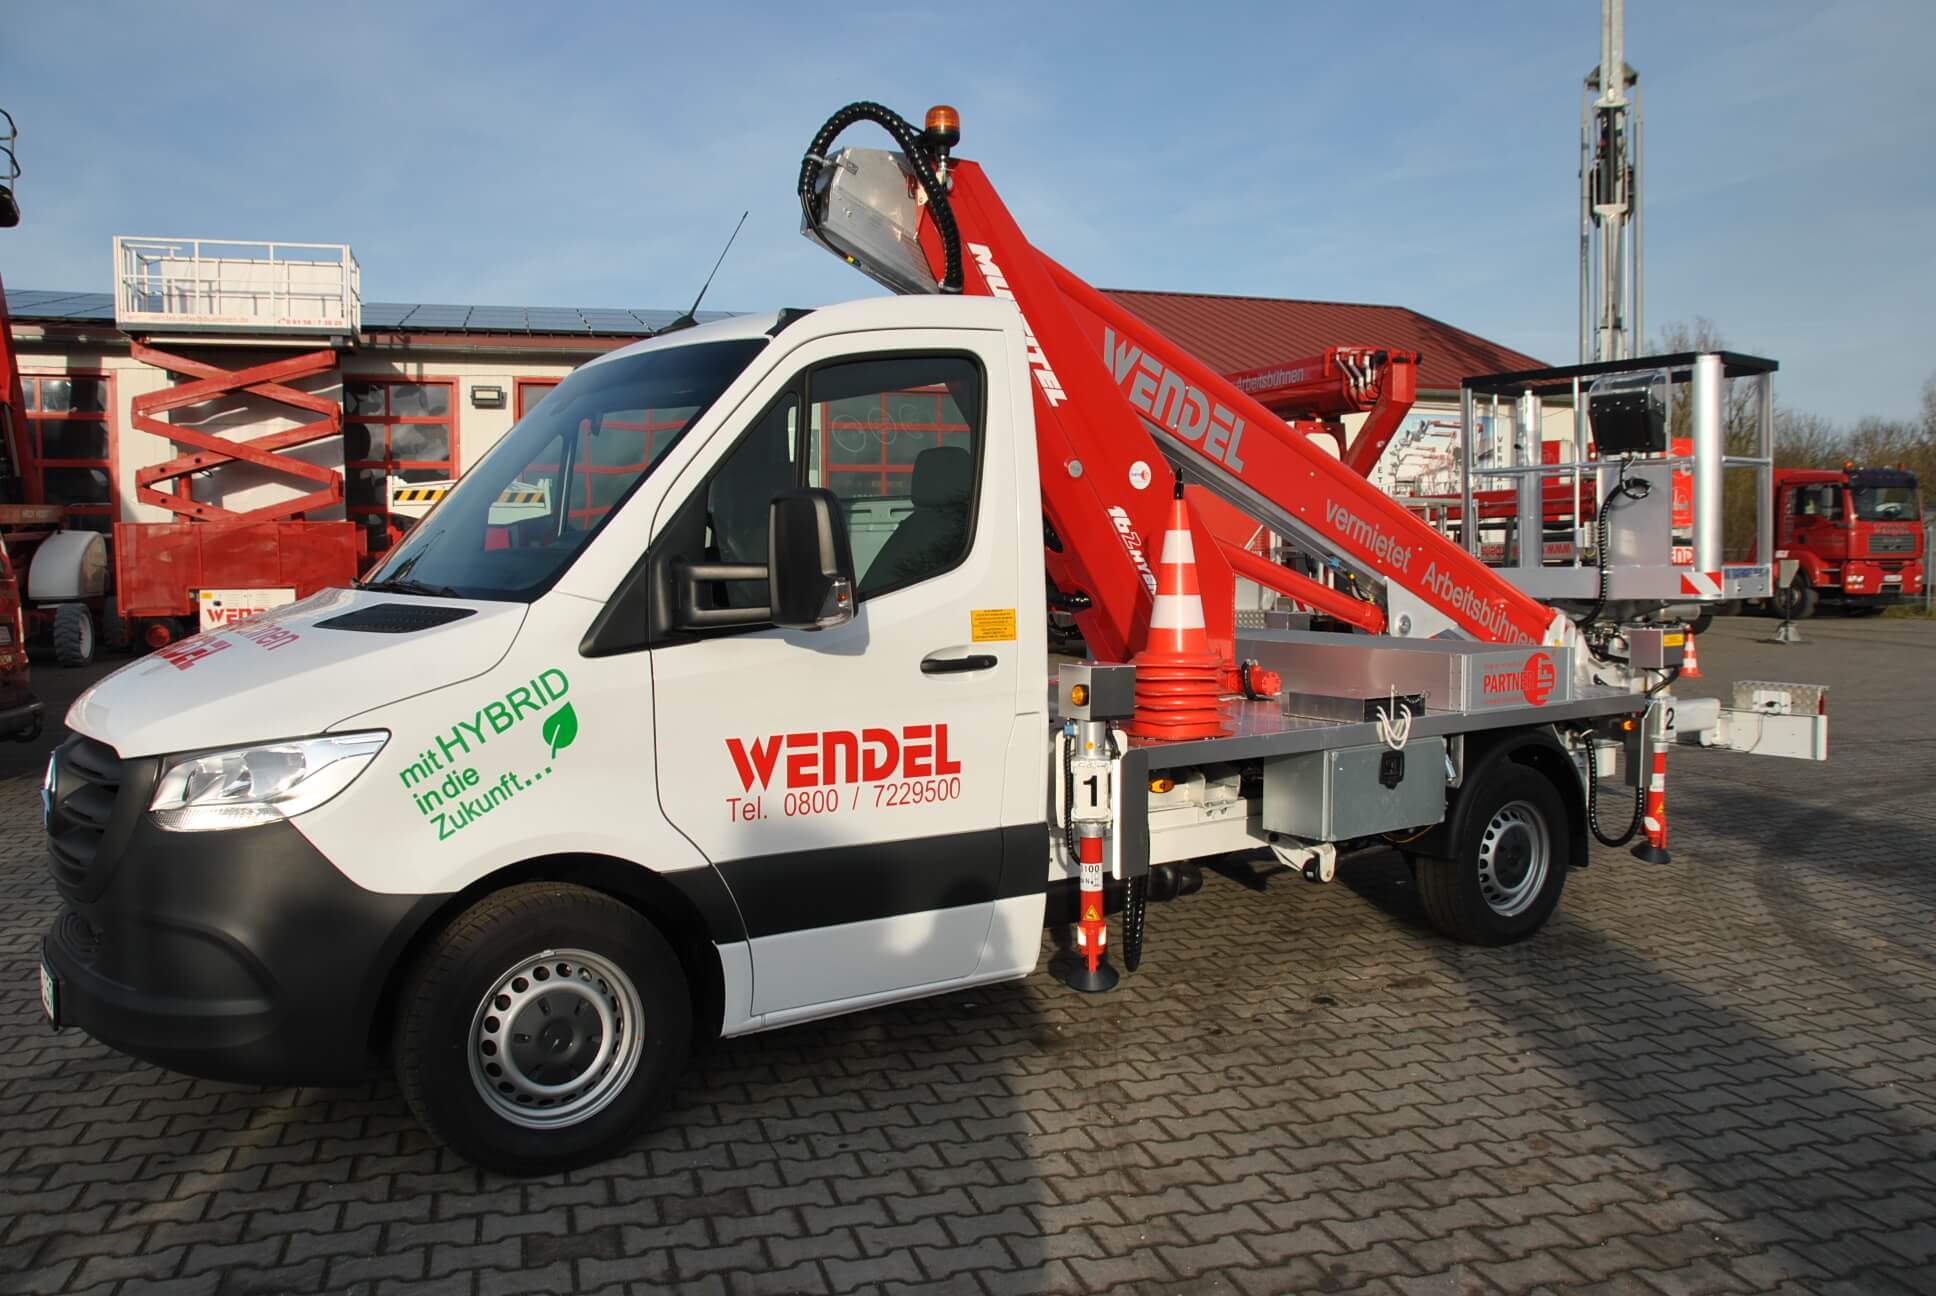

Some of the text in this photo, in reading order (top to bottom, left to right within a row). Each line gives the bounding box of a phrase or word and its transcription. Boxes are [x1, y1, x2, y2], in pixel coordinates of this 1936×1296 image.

[967, 242, 1068, 408] MUITEL
[1104, 326, 1246, 474] WENDEL
[1326, 498, 1413, 574] vermietet
[1483, 672, 1536, 694] PARTNER
[399, 668, 569, 789] mit HYBRID
[1666, 708, 1675, 730] 2
[413, 767, 480, 815] in die
[725, 723, 962, 793] WENDEL
[1083, 775, 1098, 807] 1
[430, 766, 552, 841] Zukunft...
[726, 777, 961, 822] Tel. 0800 / 7229500
